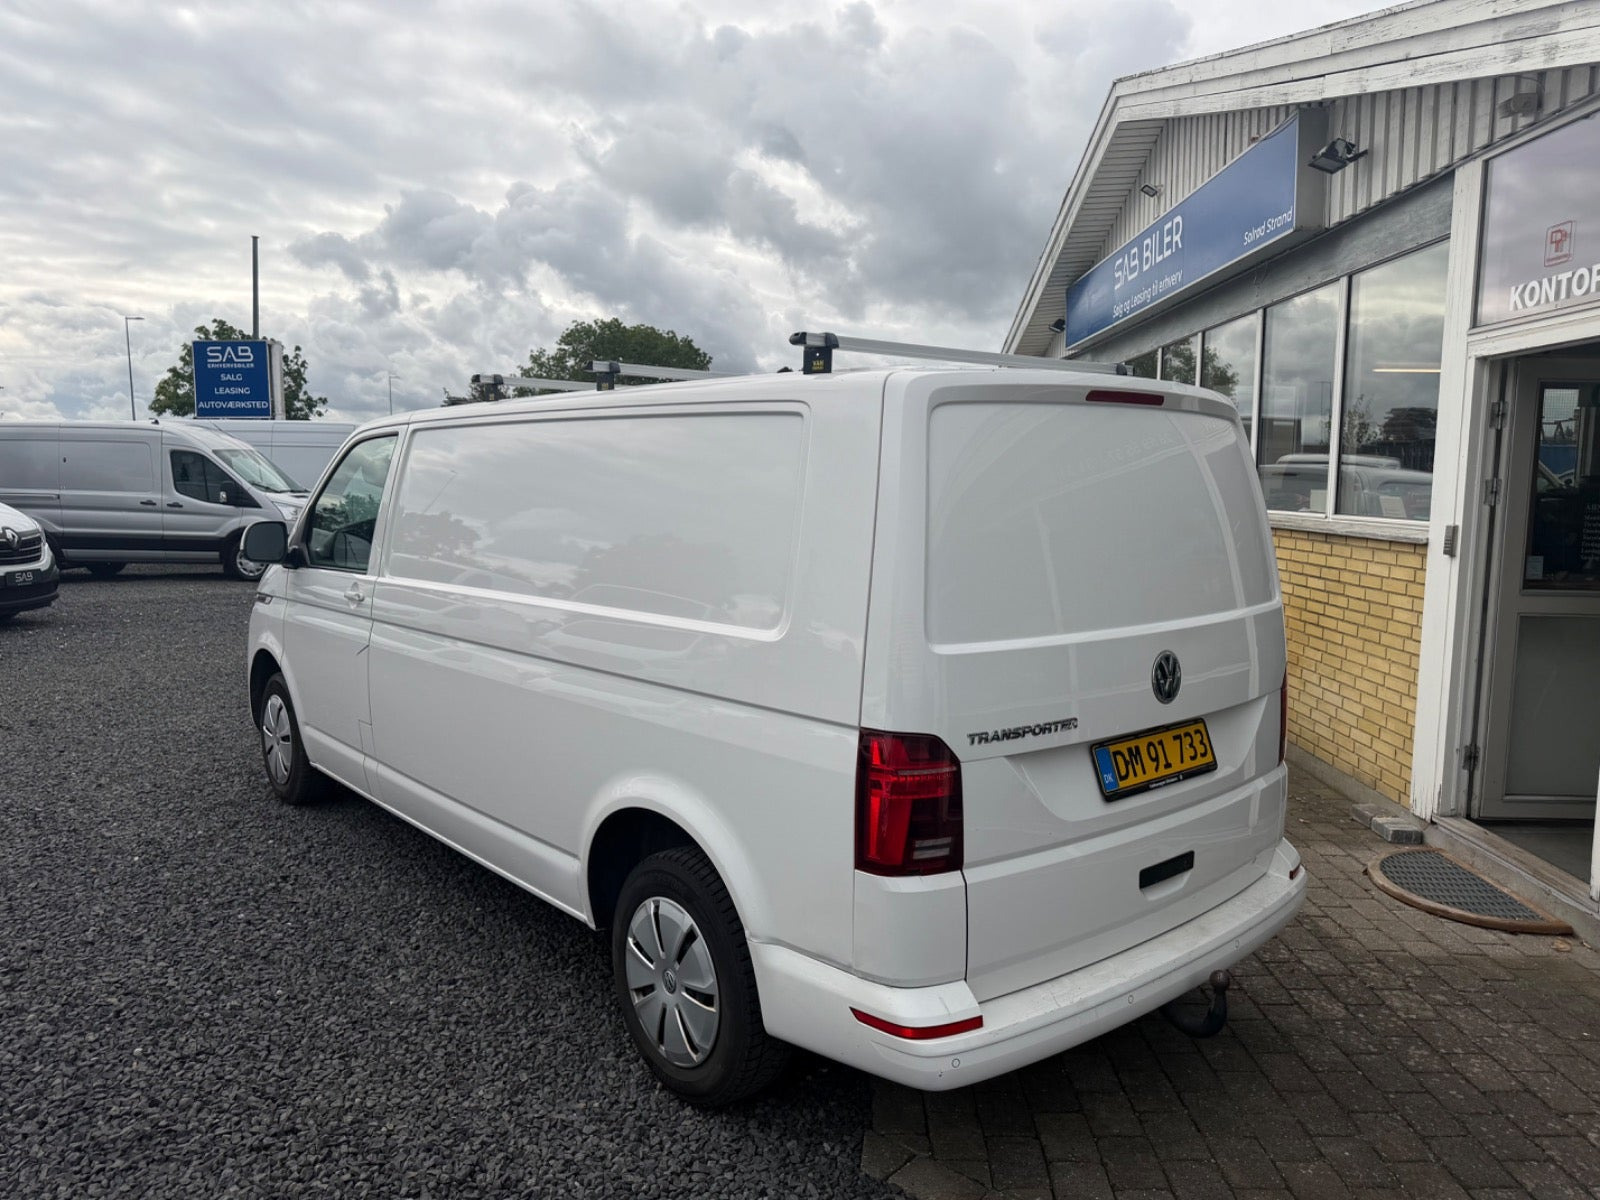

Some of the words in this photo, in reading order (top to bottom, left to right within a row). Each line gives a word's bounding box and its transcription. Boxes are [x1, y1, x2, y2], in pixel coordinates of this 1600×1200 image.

[1266, 205, 1293, 233] Strand
[1114, 246, 1139, 290] SAB
[1143, 215, 1183, 272] BILER
[1113, 303, 1123, 318] Salg
[1123, 300, 1131, 314] og
[1131, 287, 1152, 308] Leasing
[1159, 269, 1183, 293] erhverv
[207, 346, 254, 362] SAB
[220, 373, 243, 381] SALG
[214, 387, 251, 395] LEASING
[198, 401, 269, 409] AUTOVÆRKSTED
[967, 717, 1078, 746] TRANSPORTER
[1112, 745, 1147, 782] DM
[1146, 739, 1173, 773] 91
[1172, 729, 1208, 764] 733
[1103, 773, 1113, 784] DK
